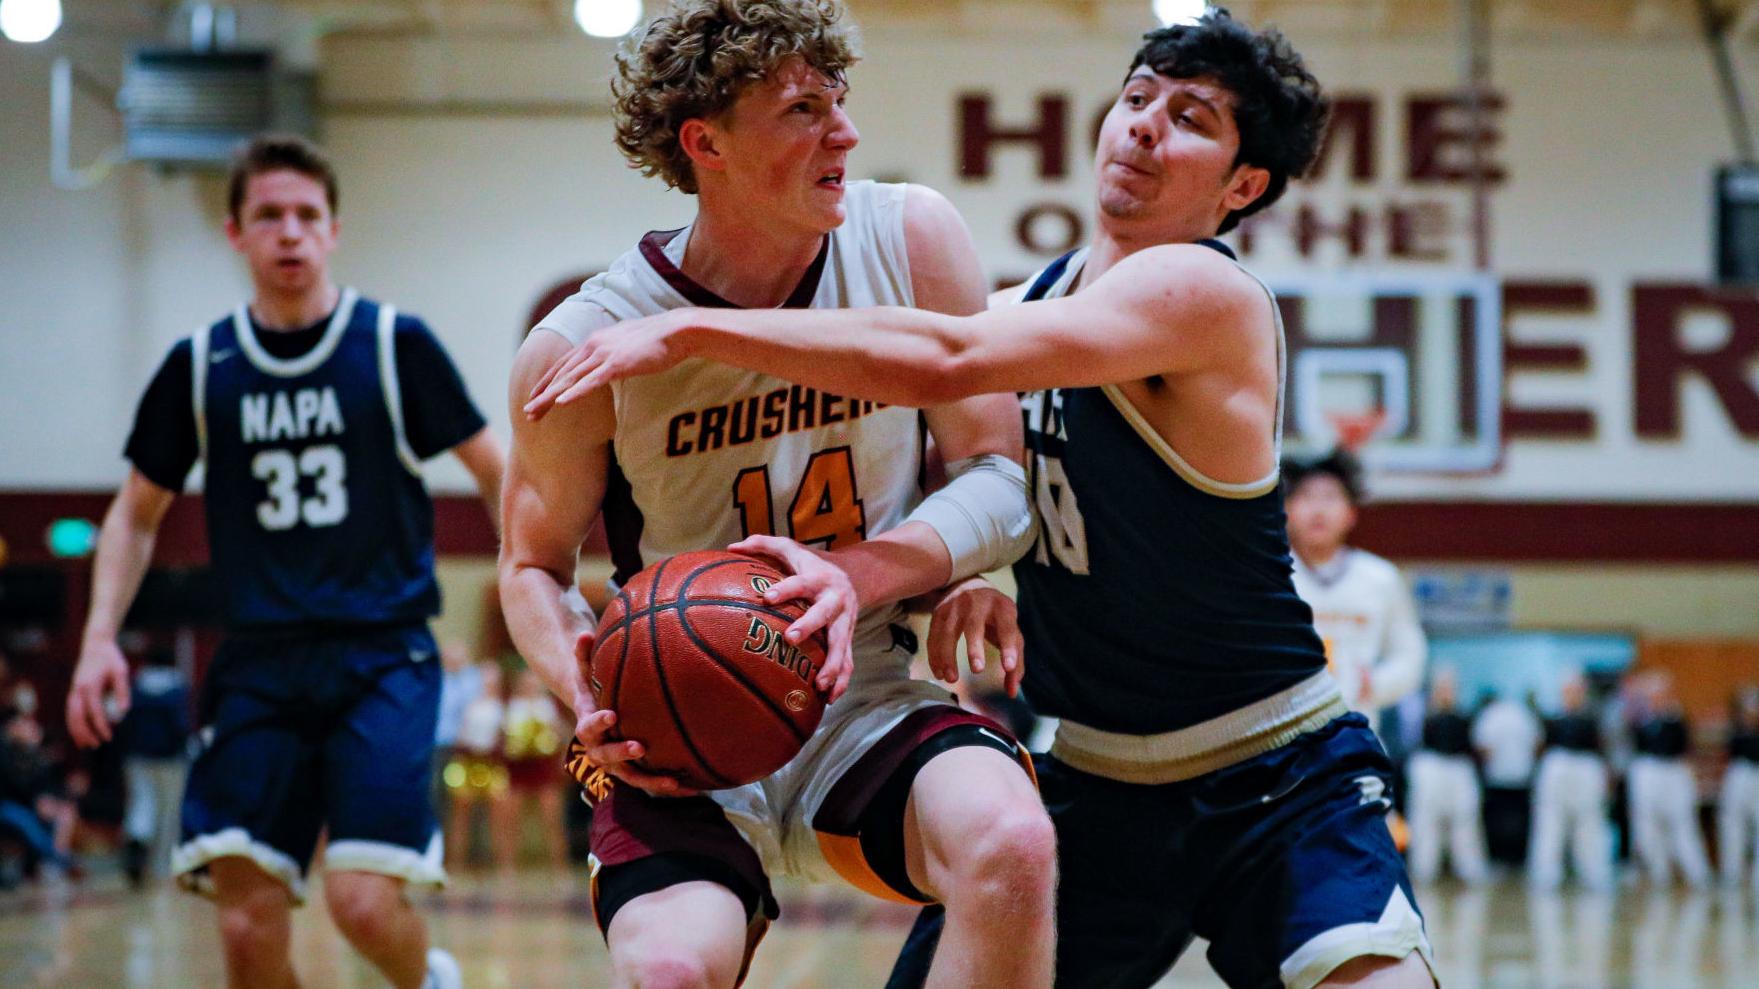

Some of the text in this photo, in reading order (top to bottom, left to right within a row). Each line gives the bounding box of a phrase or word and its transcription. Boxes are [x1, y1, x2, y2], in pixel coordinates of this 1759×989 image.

[240, 386, 345, 442] NAPA
[666, 384, 888, 457] CRUSHE
[252, 446, 349, 531] 33
[732, 445, 868, 551] 14
